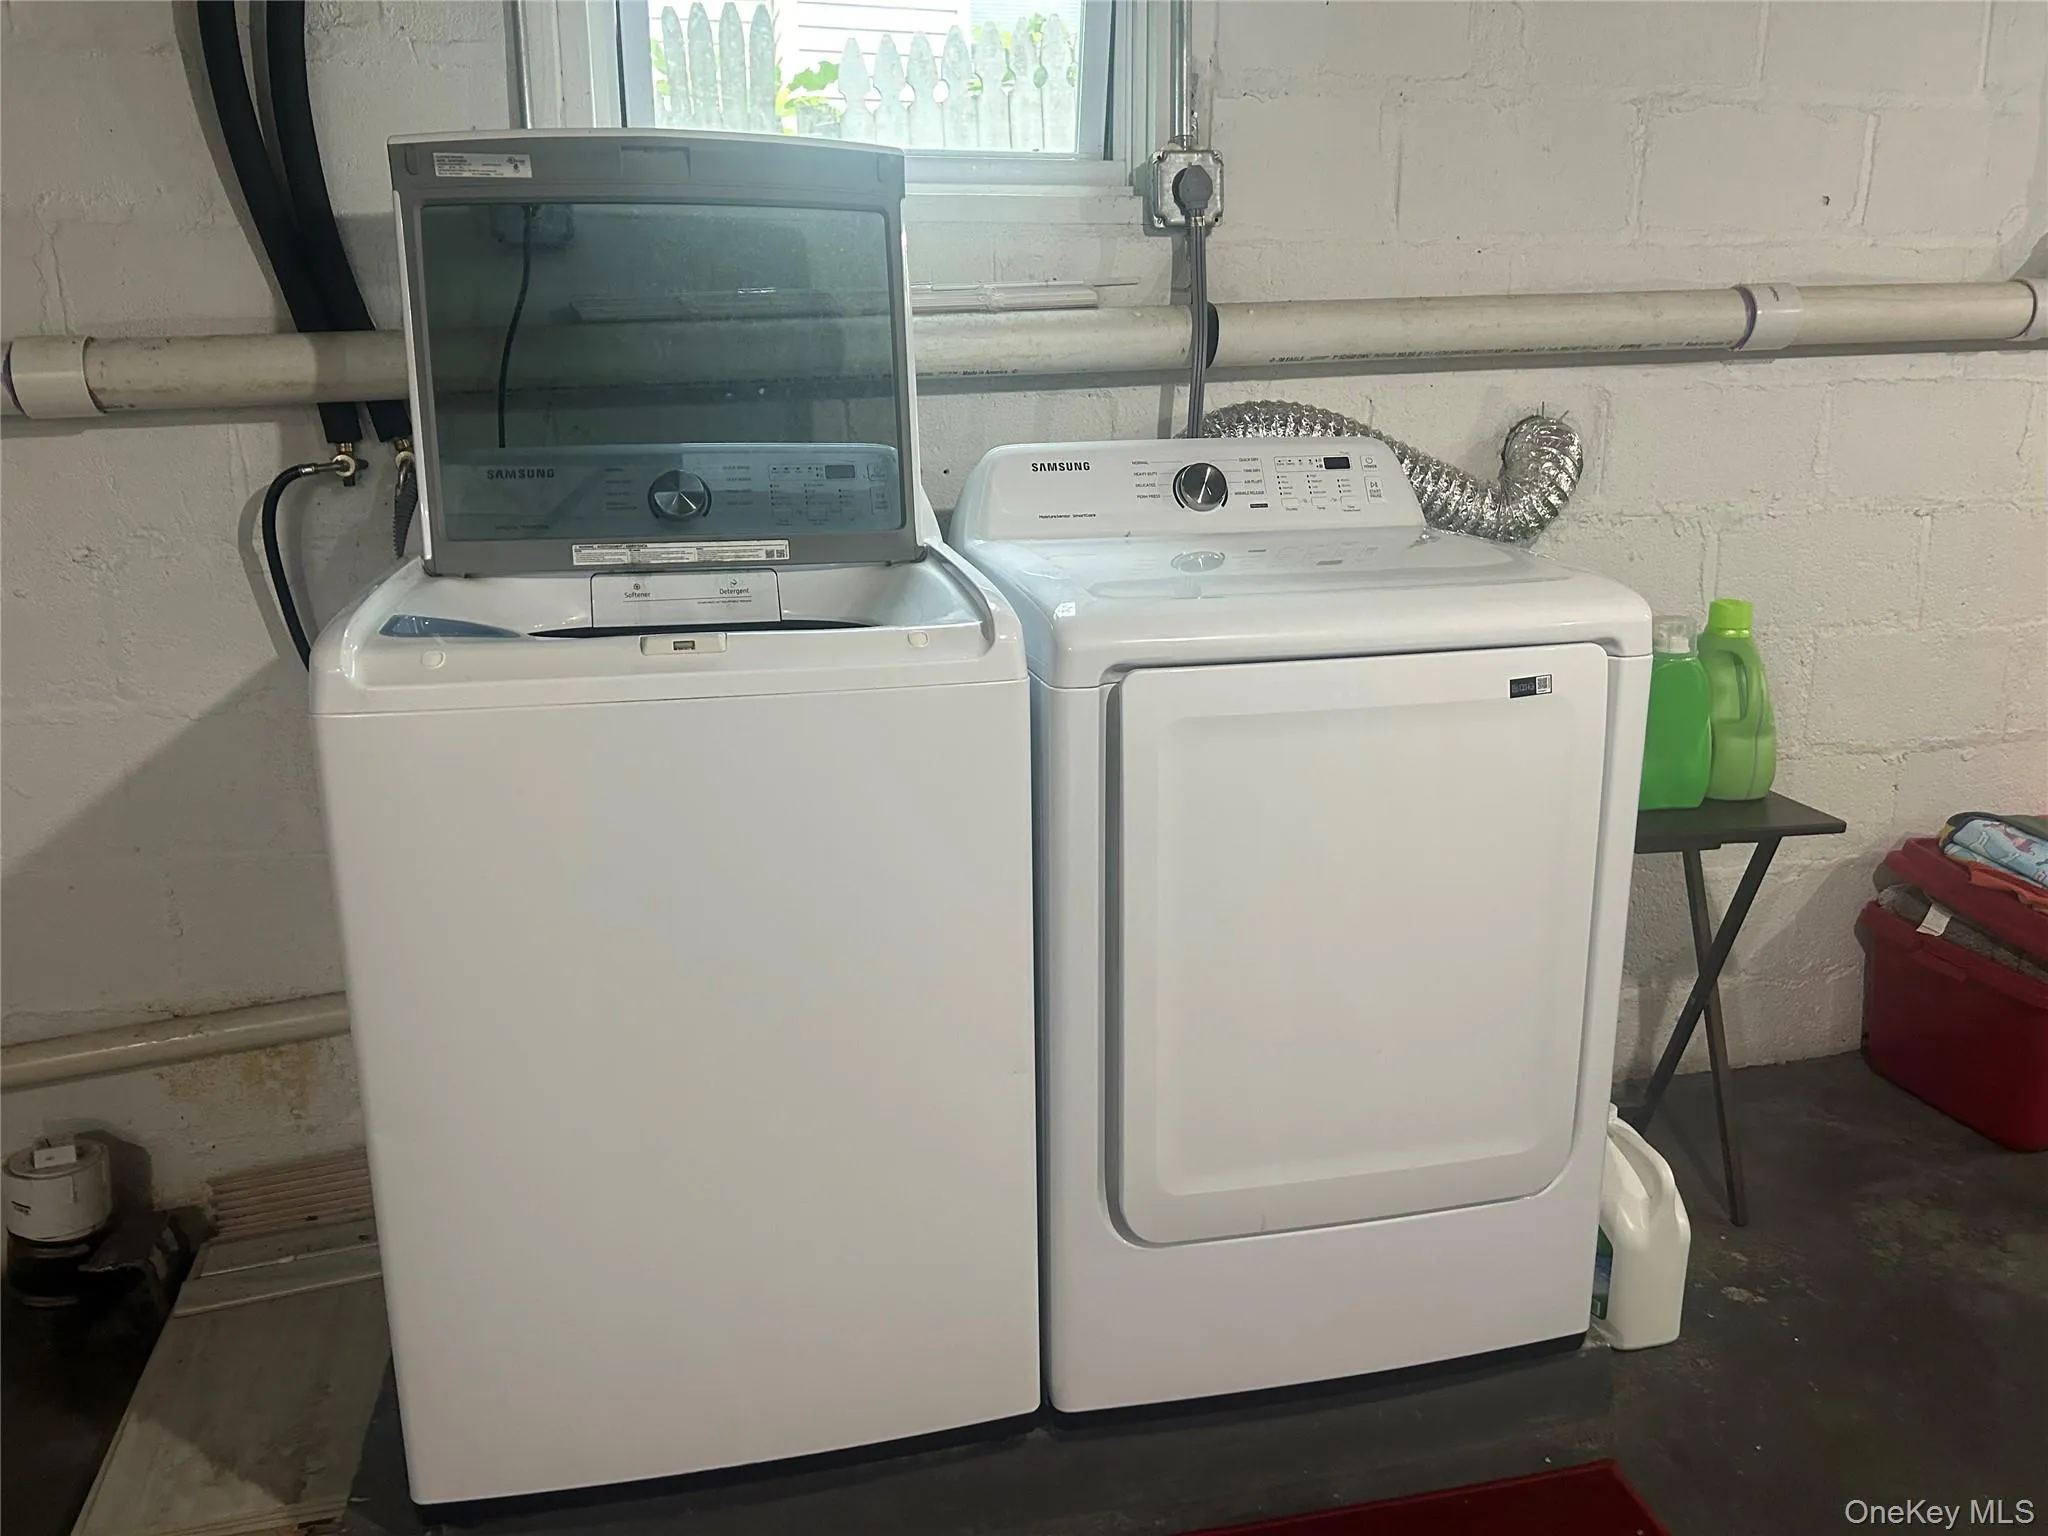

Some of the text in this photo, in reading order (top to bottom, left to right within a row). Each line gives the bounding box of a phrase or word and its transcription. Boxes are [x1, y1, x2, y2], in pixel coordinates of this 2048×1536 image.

[1031, 461, 1091, 472] SAMSUNG
[487, 468, 555, 480] SAMSUNG
[720, 587, 750, 595] Detergent
